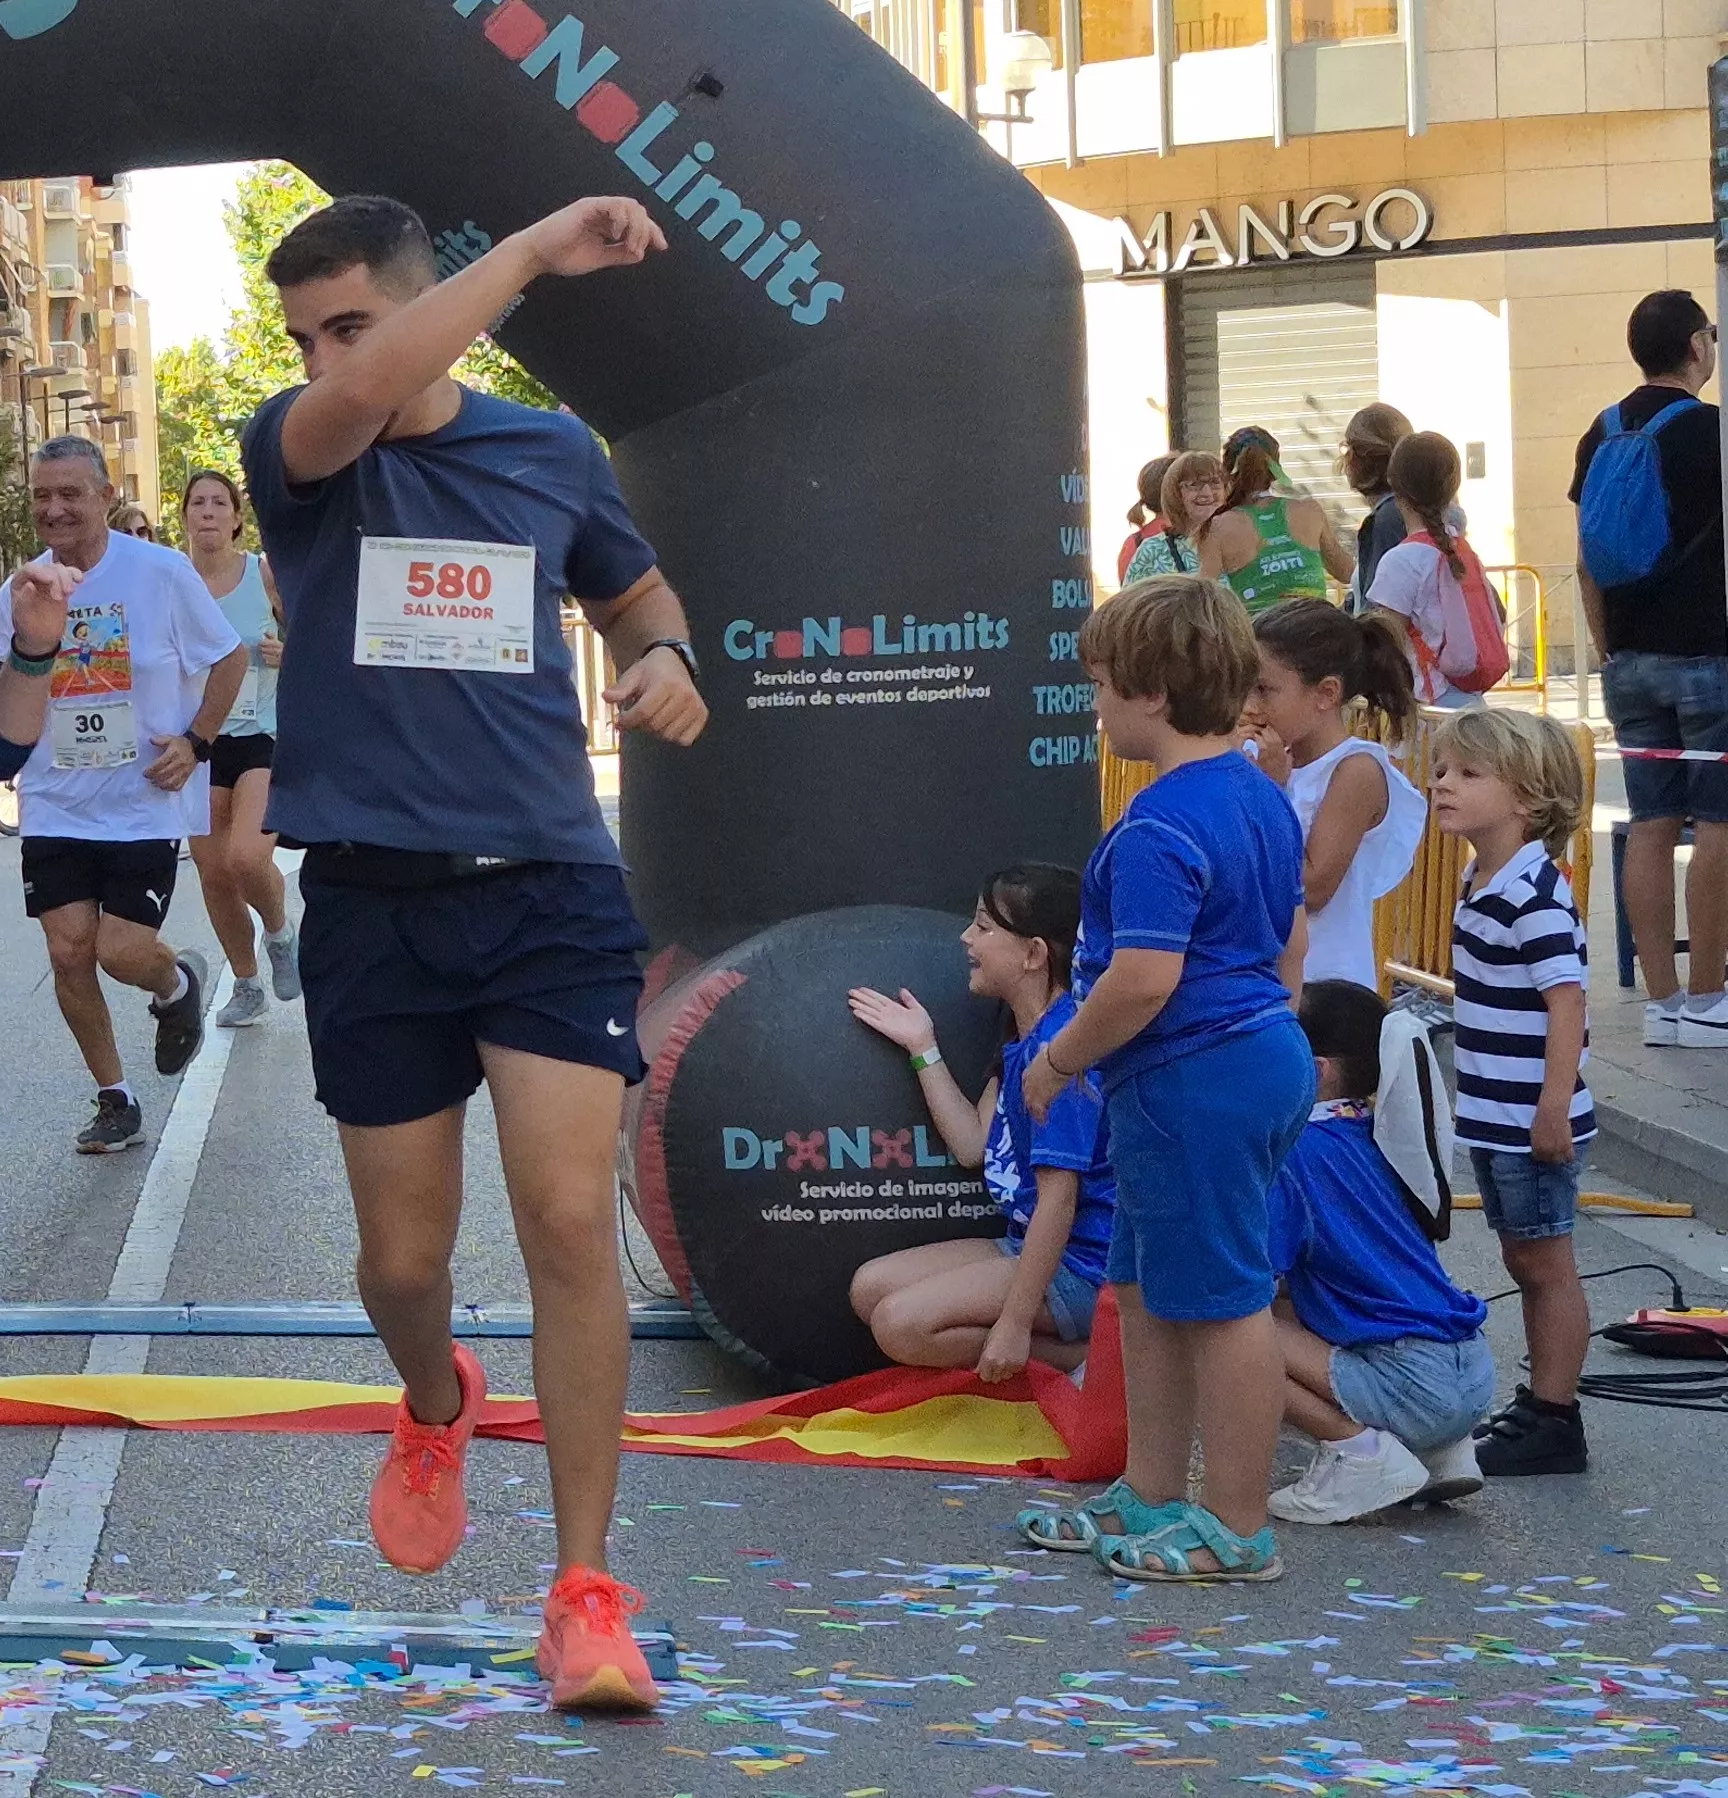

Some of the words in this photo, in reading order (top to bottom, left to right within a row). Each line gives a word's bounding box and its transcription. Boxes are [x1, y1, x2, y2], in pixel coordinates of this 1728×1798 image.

[1112, 186, 1432, 275] MANGO
[406, 561, 492, 601] 580
[403, 602, 494, 620] SALVADOR
[753, 667, 817, 687] Servicio
[820, 667, 843, 685] de
[846, 664, 961, 685] cronometraje
[963, 665, 974, 681] y
[746, 688, 807, 710] gestión
[809, 688, 832, 707] de
[835, 687, 903, 706] eventos
[906, 684, 991, 704] deportivos
[74, 713, 105, 734] 30
[1028, 735, 1080, 767] CHIP
[800, 1179, 874, 1198] Servicio
[878, 1179, 904, 1198] de
[908, 1180, 984, 1198] imagen
[761, 1202, 815, 1222] vídeo
[819, 1201, 943, 1225] promocional
[948, 1200, 999, 1220] depo
